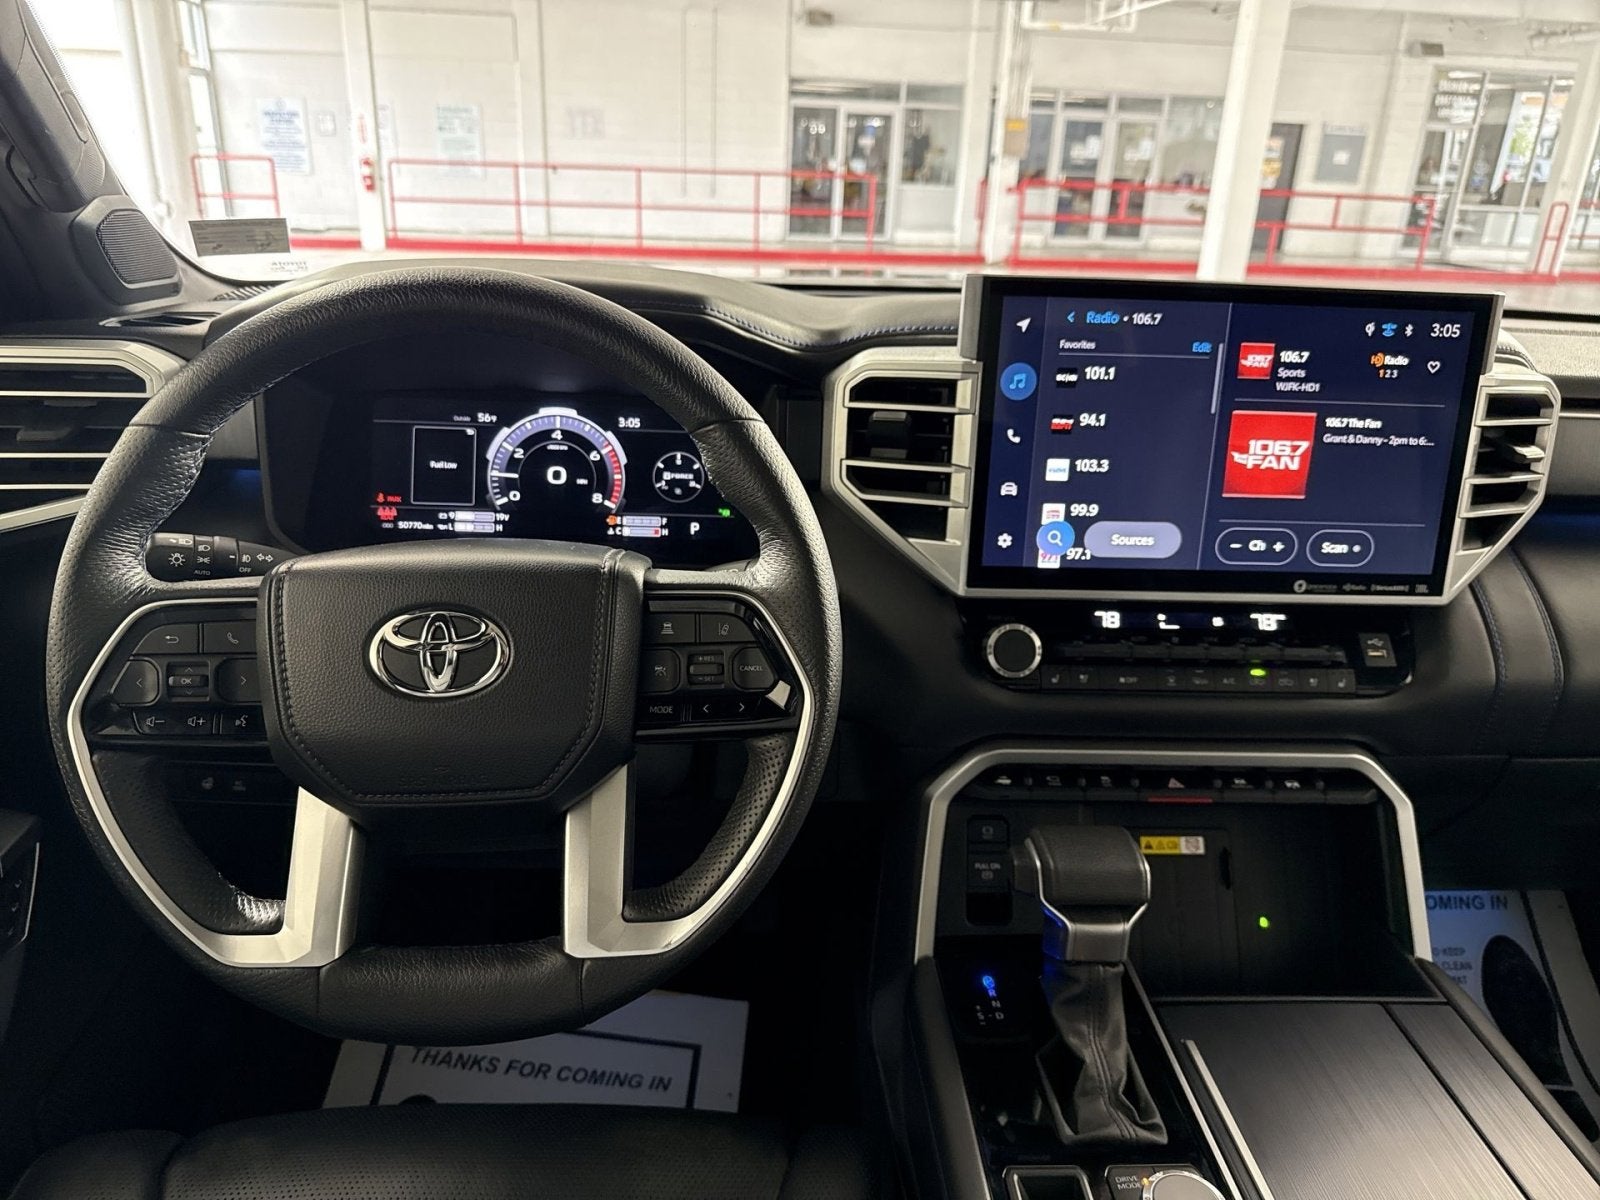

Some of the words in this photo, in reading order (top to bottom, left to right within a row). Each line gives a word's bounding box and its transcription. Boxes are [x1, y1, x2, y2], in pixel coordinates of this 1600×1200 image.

[1086, 311, 1120, 324] Radio
[1132, 312, 1162, 326] 106.7
[1430, 323, 1461, 338] 3:05
[1059, 338, 1096, 350] Favorites
[1192, 341, 1212, 353] Edit
[1279, 351, 1310, 363] 106.7
[1084, 366, 1116, 380] 101.1
[1277, 367, 1306, 379] Sports
[618, 417, 641, 429] 3:05
[1079, 413, 1106, 427] 94.1
[1365, 419, 1382, 429] Fan
[551, 430, 563, 440] 4
[1323, 434, 1347, 443] Grant
[1356, 434, 1384, 446] Danny
[1389, 436, 1408, 446] 2pm
[1409, 437, 1418, 446] to
[513, 448, 524, 459] 2
[589, 450, 601, 462] 6
[430, 460, 444, 469] Fuel
[444, 461, 458, 470] Low
[1075, 459, 1109, 473] 103.3
[1246, 455, 1300, 471] FAN
[547, 465, 567, 485] 0
[509, 490, 521, 501] 0
[591, 492, 604, 504] 8
[1070, 503, 1098, 517] 99.9
[662, 517, 668, 526] F
[662, 528, 669, 536] H
[690, 522, 700, 536] P
[1111, 533, 1155, 547] Sources
[1066, 547, 1091, 561] 97.1
[1321, 542, 1349, 554] Scan
[180, 676, 192, 684] OK
[650, 706, 673, 714] MODE
[1426, 895, 1486, 911] OMING
[1490, 895, 1508, 911] IN
[995, 1011, 1005, 1020] D
[410, 1047, 501, 1074] THANKS
[504, 1059, 551, 1081] FOR
[555, 1066, 643, 1089] COMING
[648, 1075, 673, 1092] IN
[1115, 1175, 1138, 1183] DRIVE
[1117, 1182, 1141, 1190] MODE
